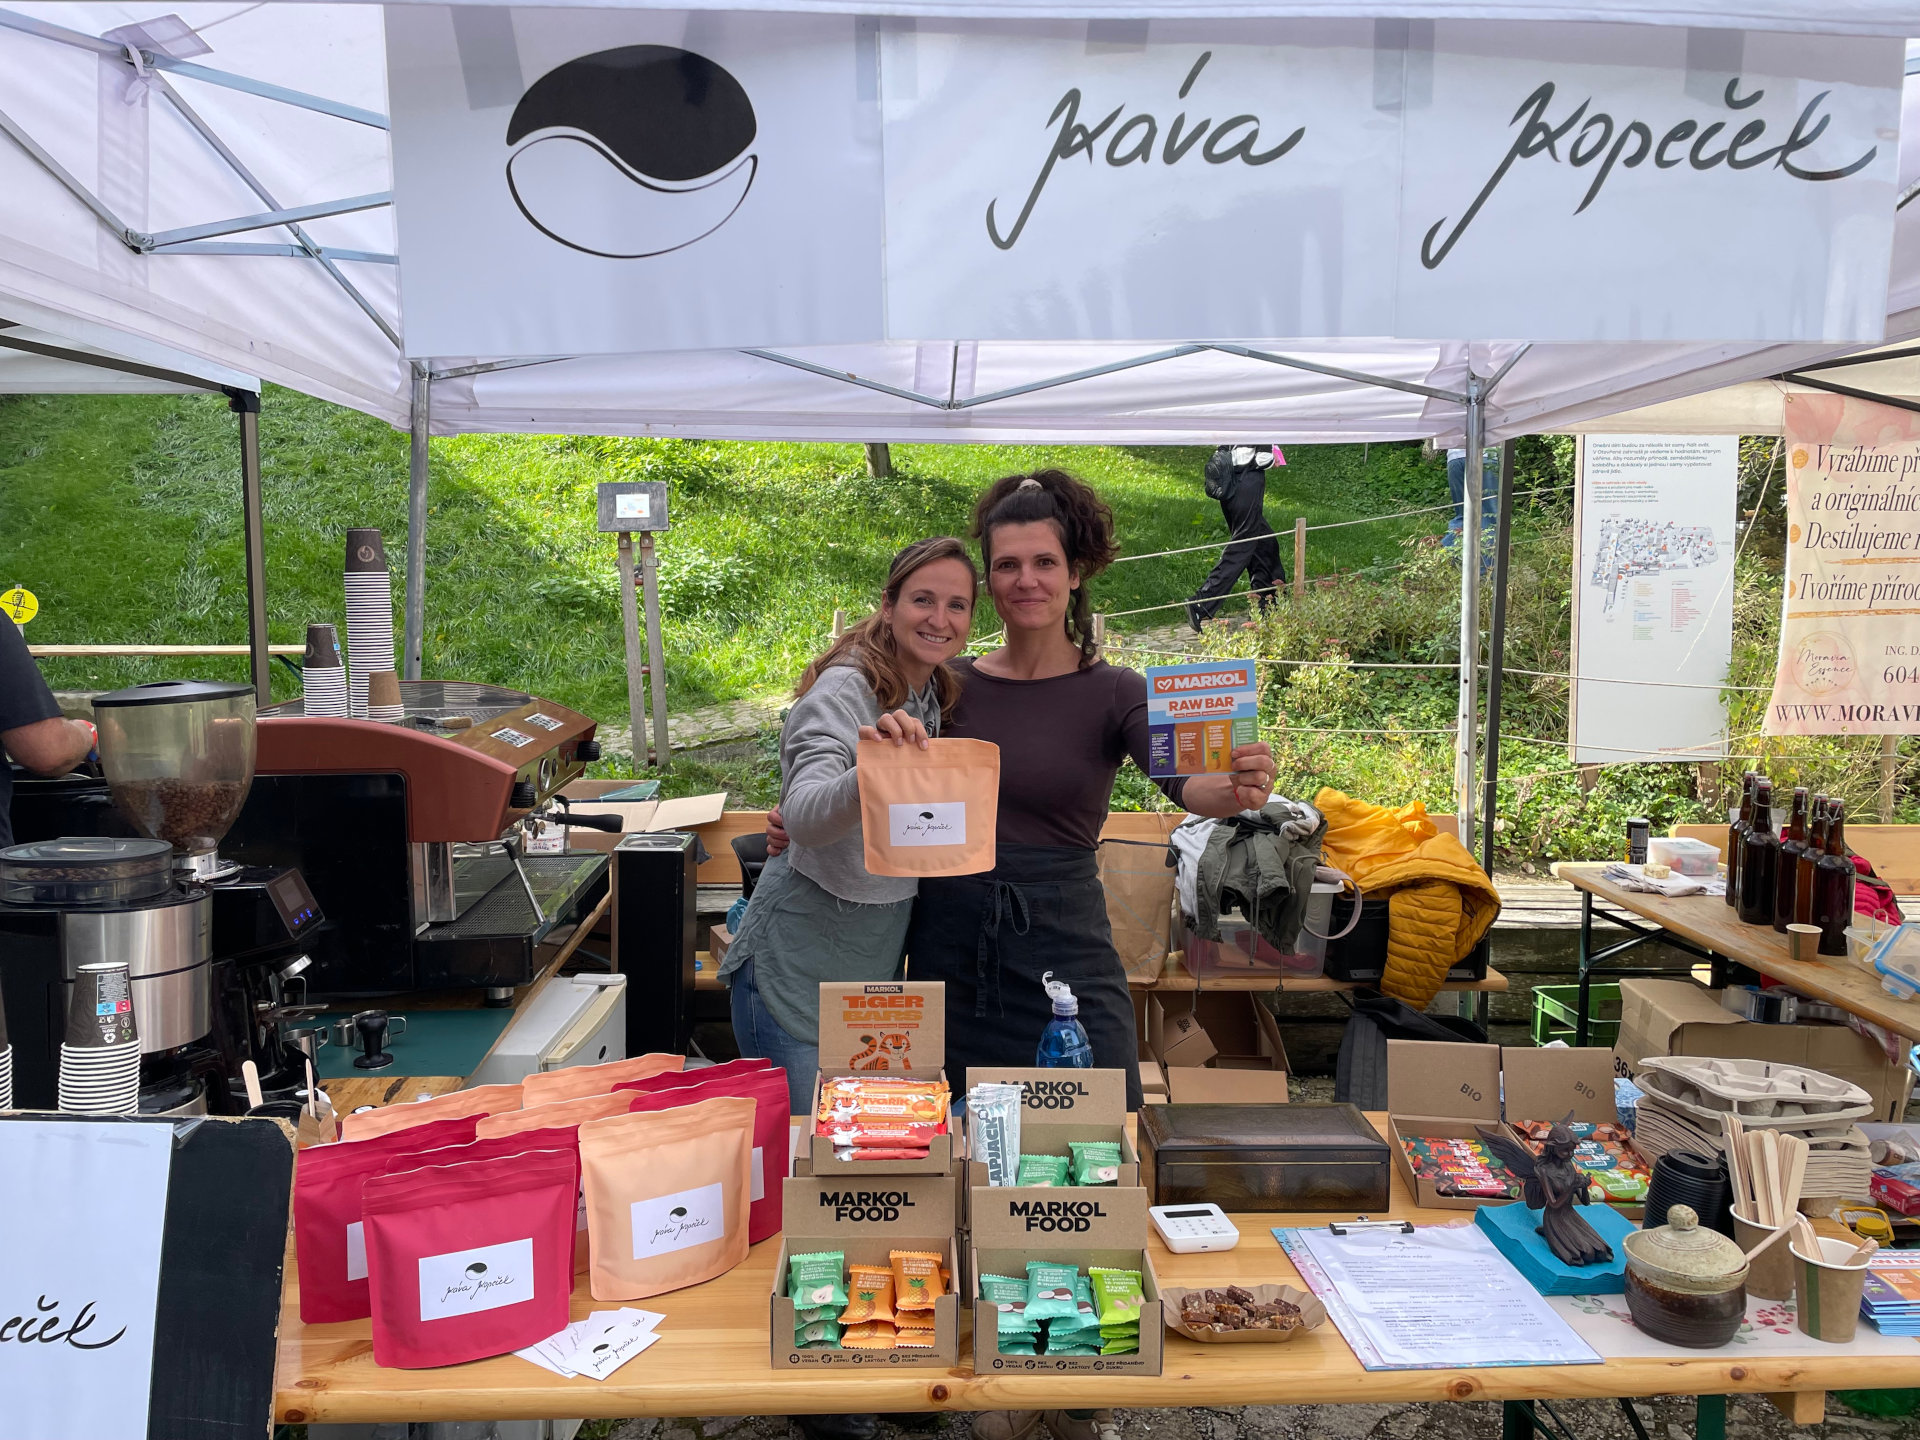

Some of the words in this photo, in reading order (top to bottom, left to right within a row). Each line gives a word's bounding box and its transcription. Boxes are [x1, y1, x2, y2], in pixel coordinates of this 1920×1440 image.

[986, 51, 1305, 249] káva
[1817, 444, 1899, 481] Vyrábíme
[1811, 492, 1821, 511] a
[1804, 521, 1911, 558] Destilujeme
[1800, 573, 1867, 601] Tvoříme
[1796, 647, 1849, 665] Moravia
[1885, 645, 1908, 656] ING.
[1174, 673, 1245, 690] MARKOL
[1883, 665, 1920, 684] 604
[1169, 699, 1203, 712] RAW
[1205, 696, 1234, 709] BAR
[843, 1010, 923, 1022] BARS
[1460, 1083, 1482, 1102] BIO
[1574, 1081, 1596, 1100] BIO
[819, 1191, 916, 1207] MARKOL
[835, 1207, 900, 1222] FOOD
[1009, 1201, 1107, 1217] MARKOL
[1026, 1216, 1091, 1232] FOOD
